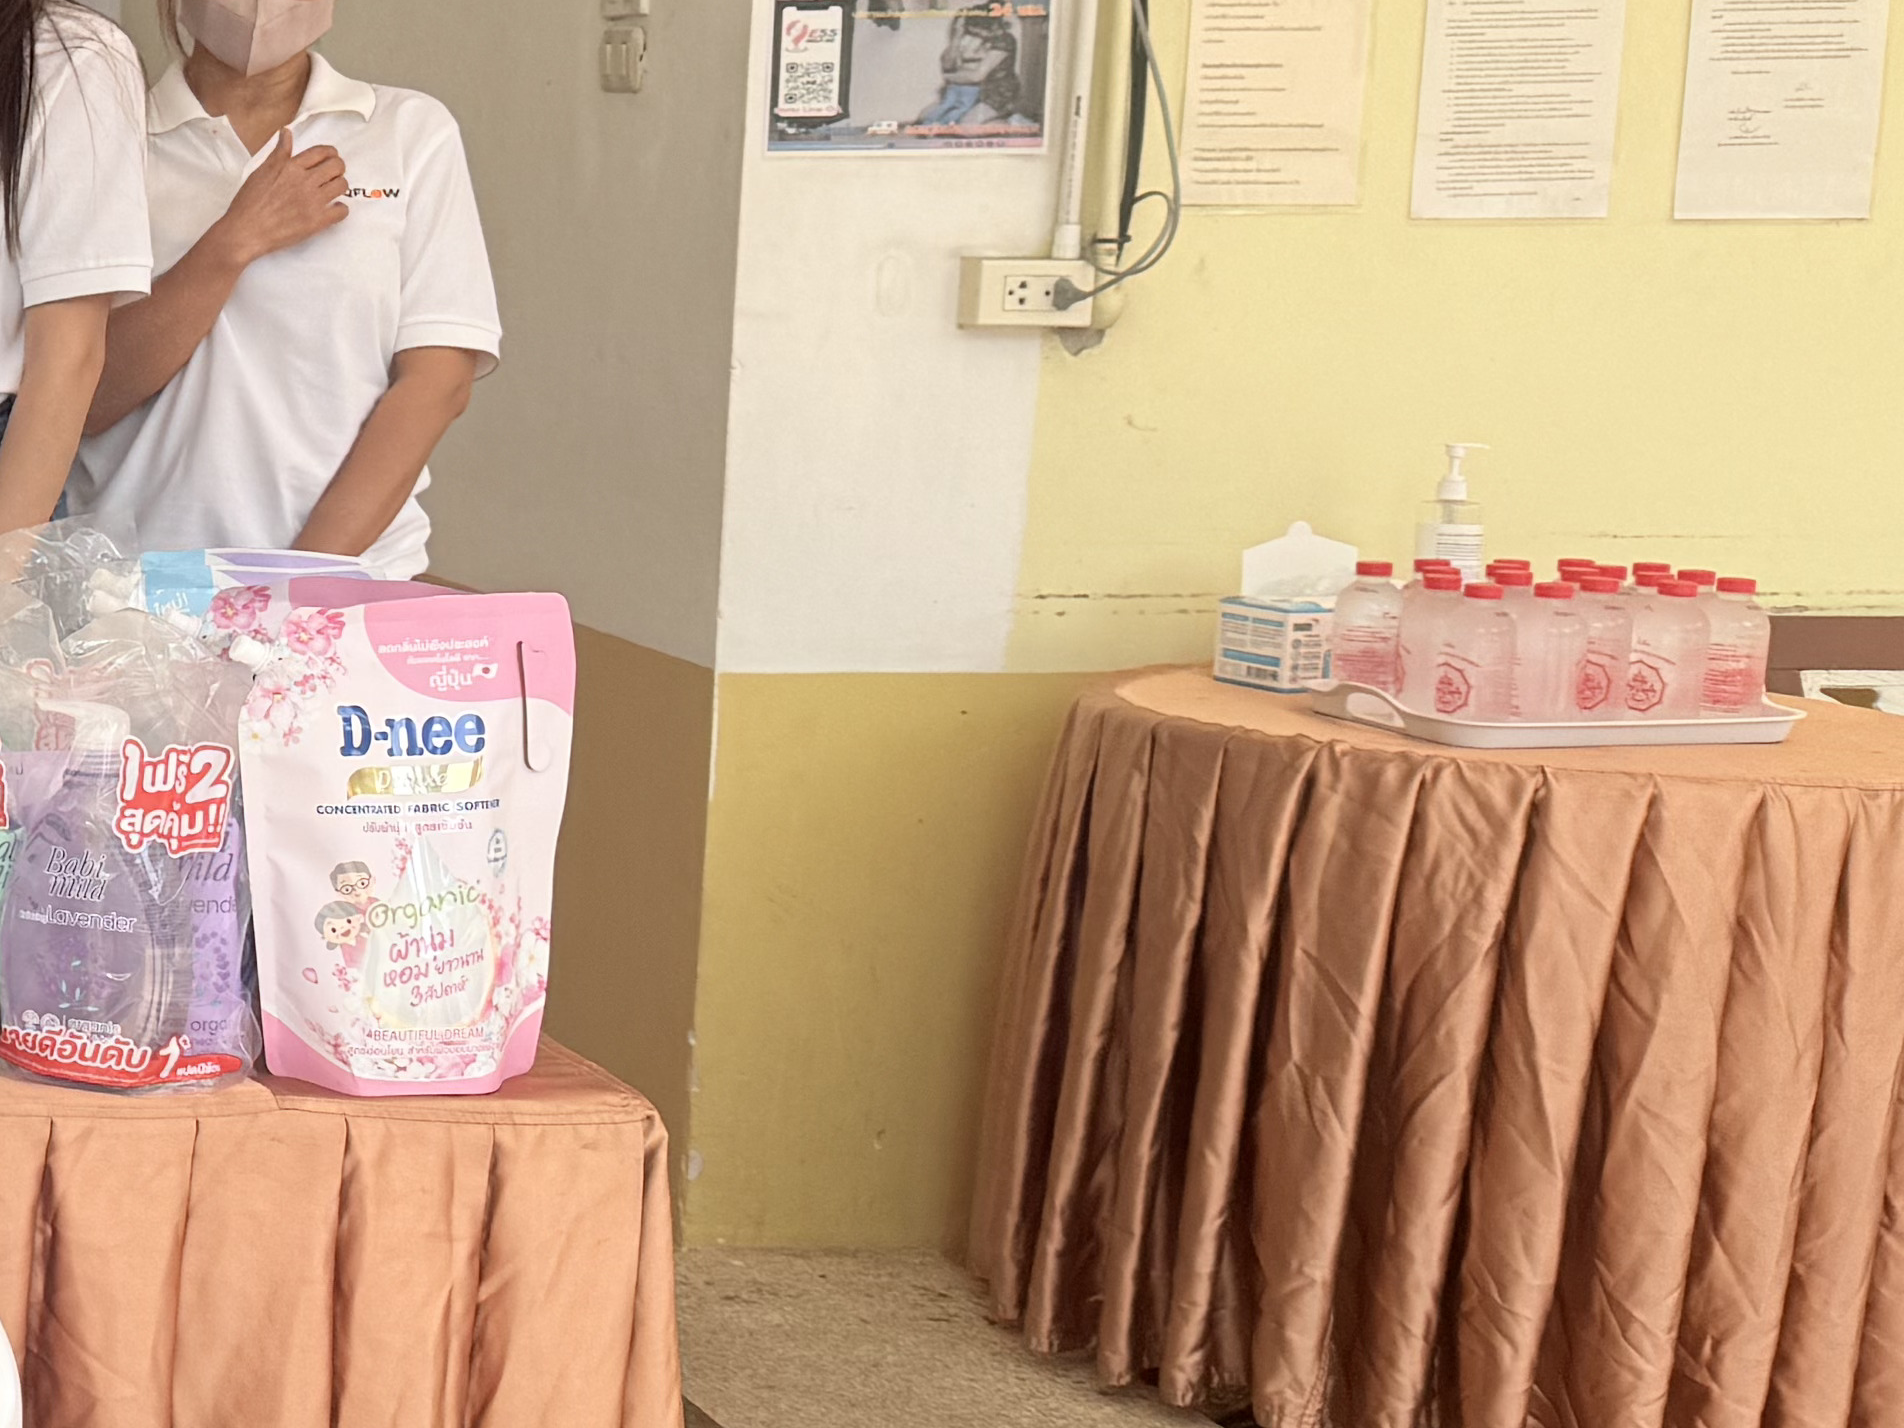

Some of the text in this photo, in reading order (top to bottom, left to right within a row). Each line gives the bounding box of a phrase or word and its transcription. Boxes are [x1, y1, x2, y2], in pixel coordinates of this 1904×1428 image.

[337, 704, 486, 757] D-nee
[316, 805, 401, 814] CONCENTRATED
[407, 802, 450, 814] FABRIC
[45, 846, 107, 876] Babi
[47, 905, 137, 932] Lavender
[368, 884, 480, 929] Organic
